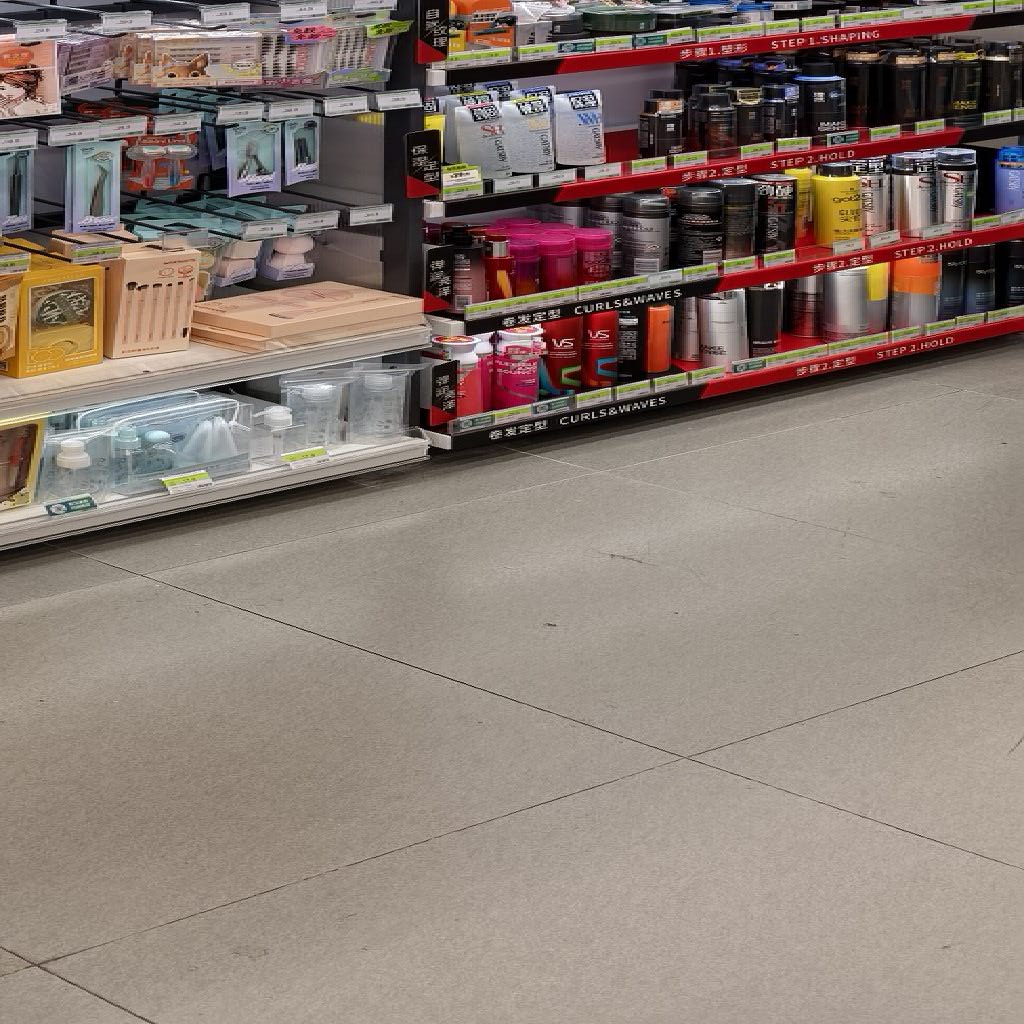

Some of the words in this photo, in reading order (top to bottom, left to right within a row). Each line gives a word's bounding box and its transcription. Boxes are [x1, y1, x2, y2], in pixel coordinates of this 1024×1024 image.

[771, 36, 806, 49] STEP
[769, 155, 804, 169] STEP
[893, 246, 925, 258] STEP
[876, 347, 907, 360] STEP
